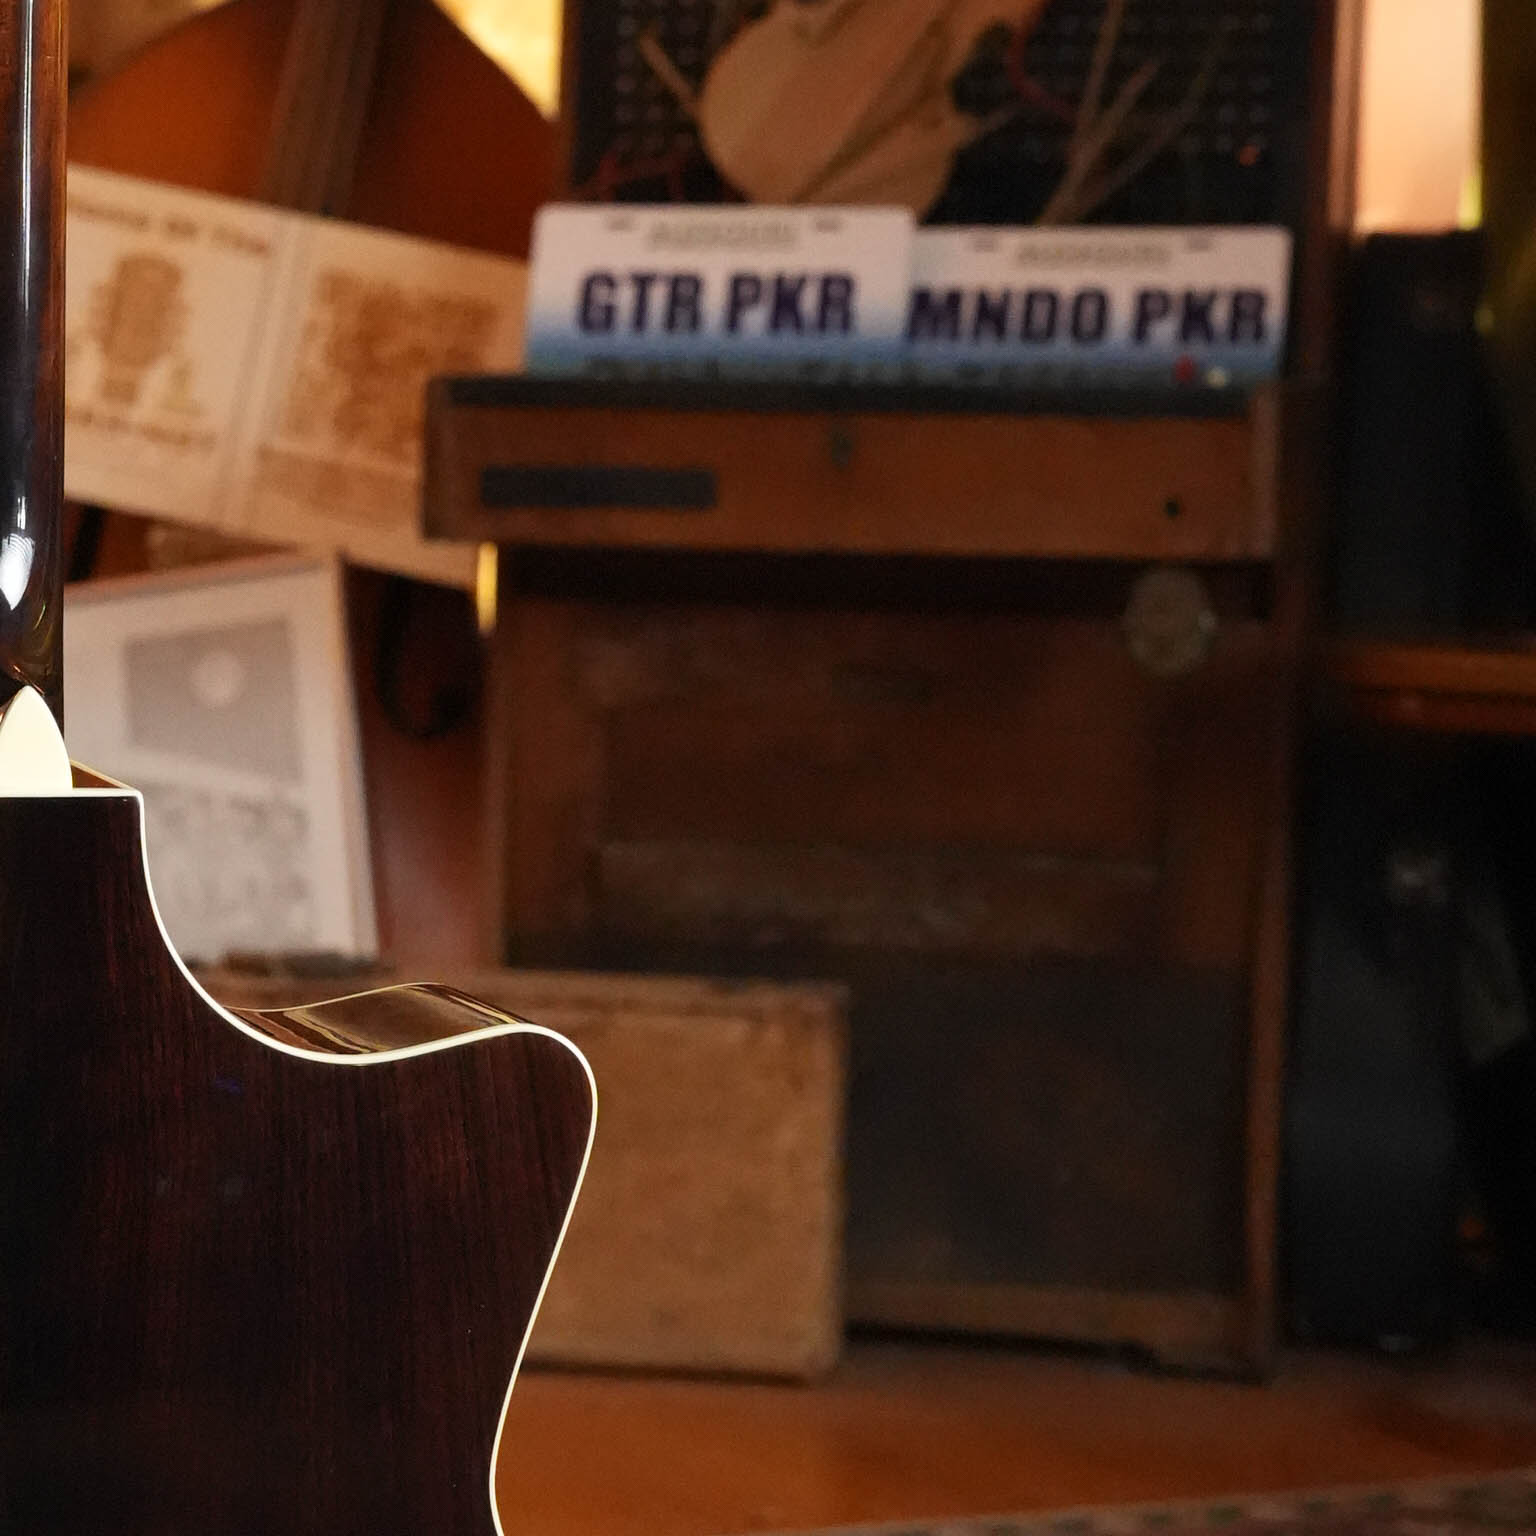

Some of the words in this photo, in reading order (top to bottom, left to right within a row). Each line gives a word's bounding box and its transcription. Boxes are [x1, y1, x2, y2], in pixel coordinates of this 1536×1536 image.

[576, 272, 702, 335] GTR
[726, 272, 854, 335] PKR
[907, 286, 1108, 345] MNDO
[1131, 287, 1266, 346] PKR
